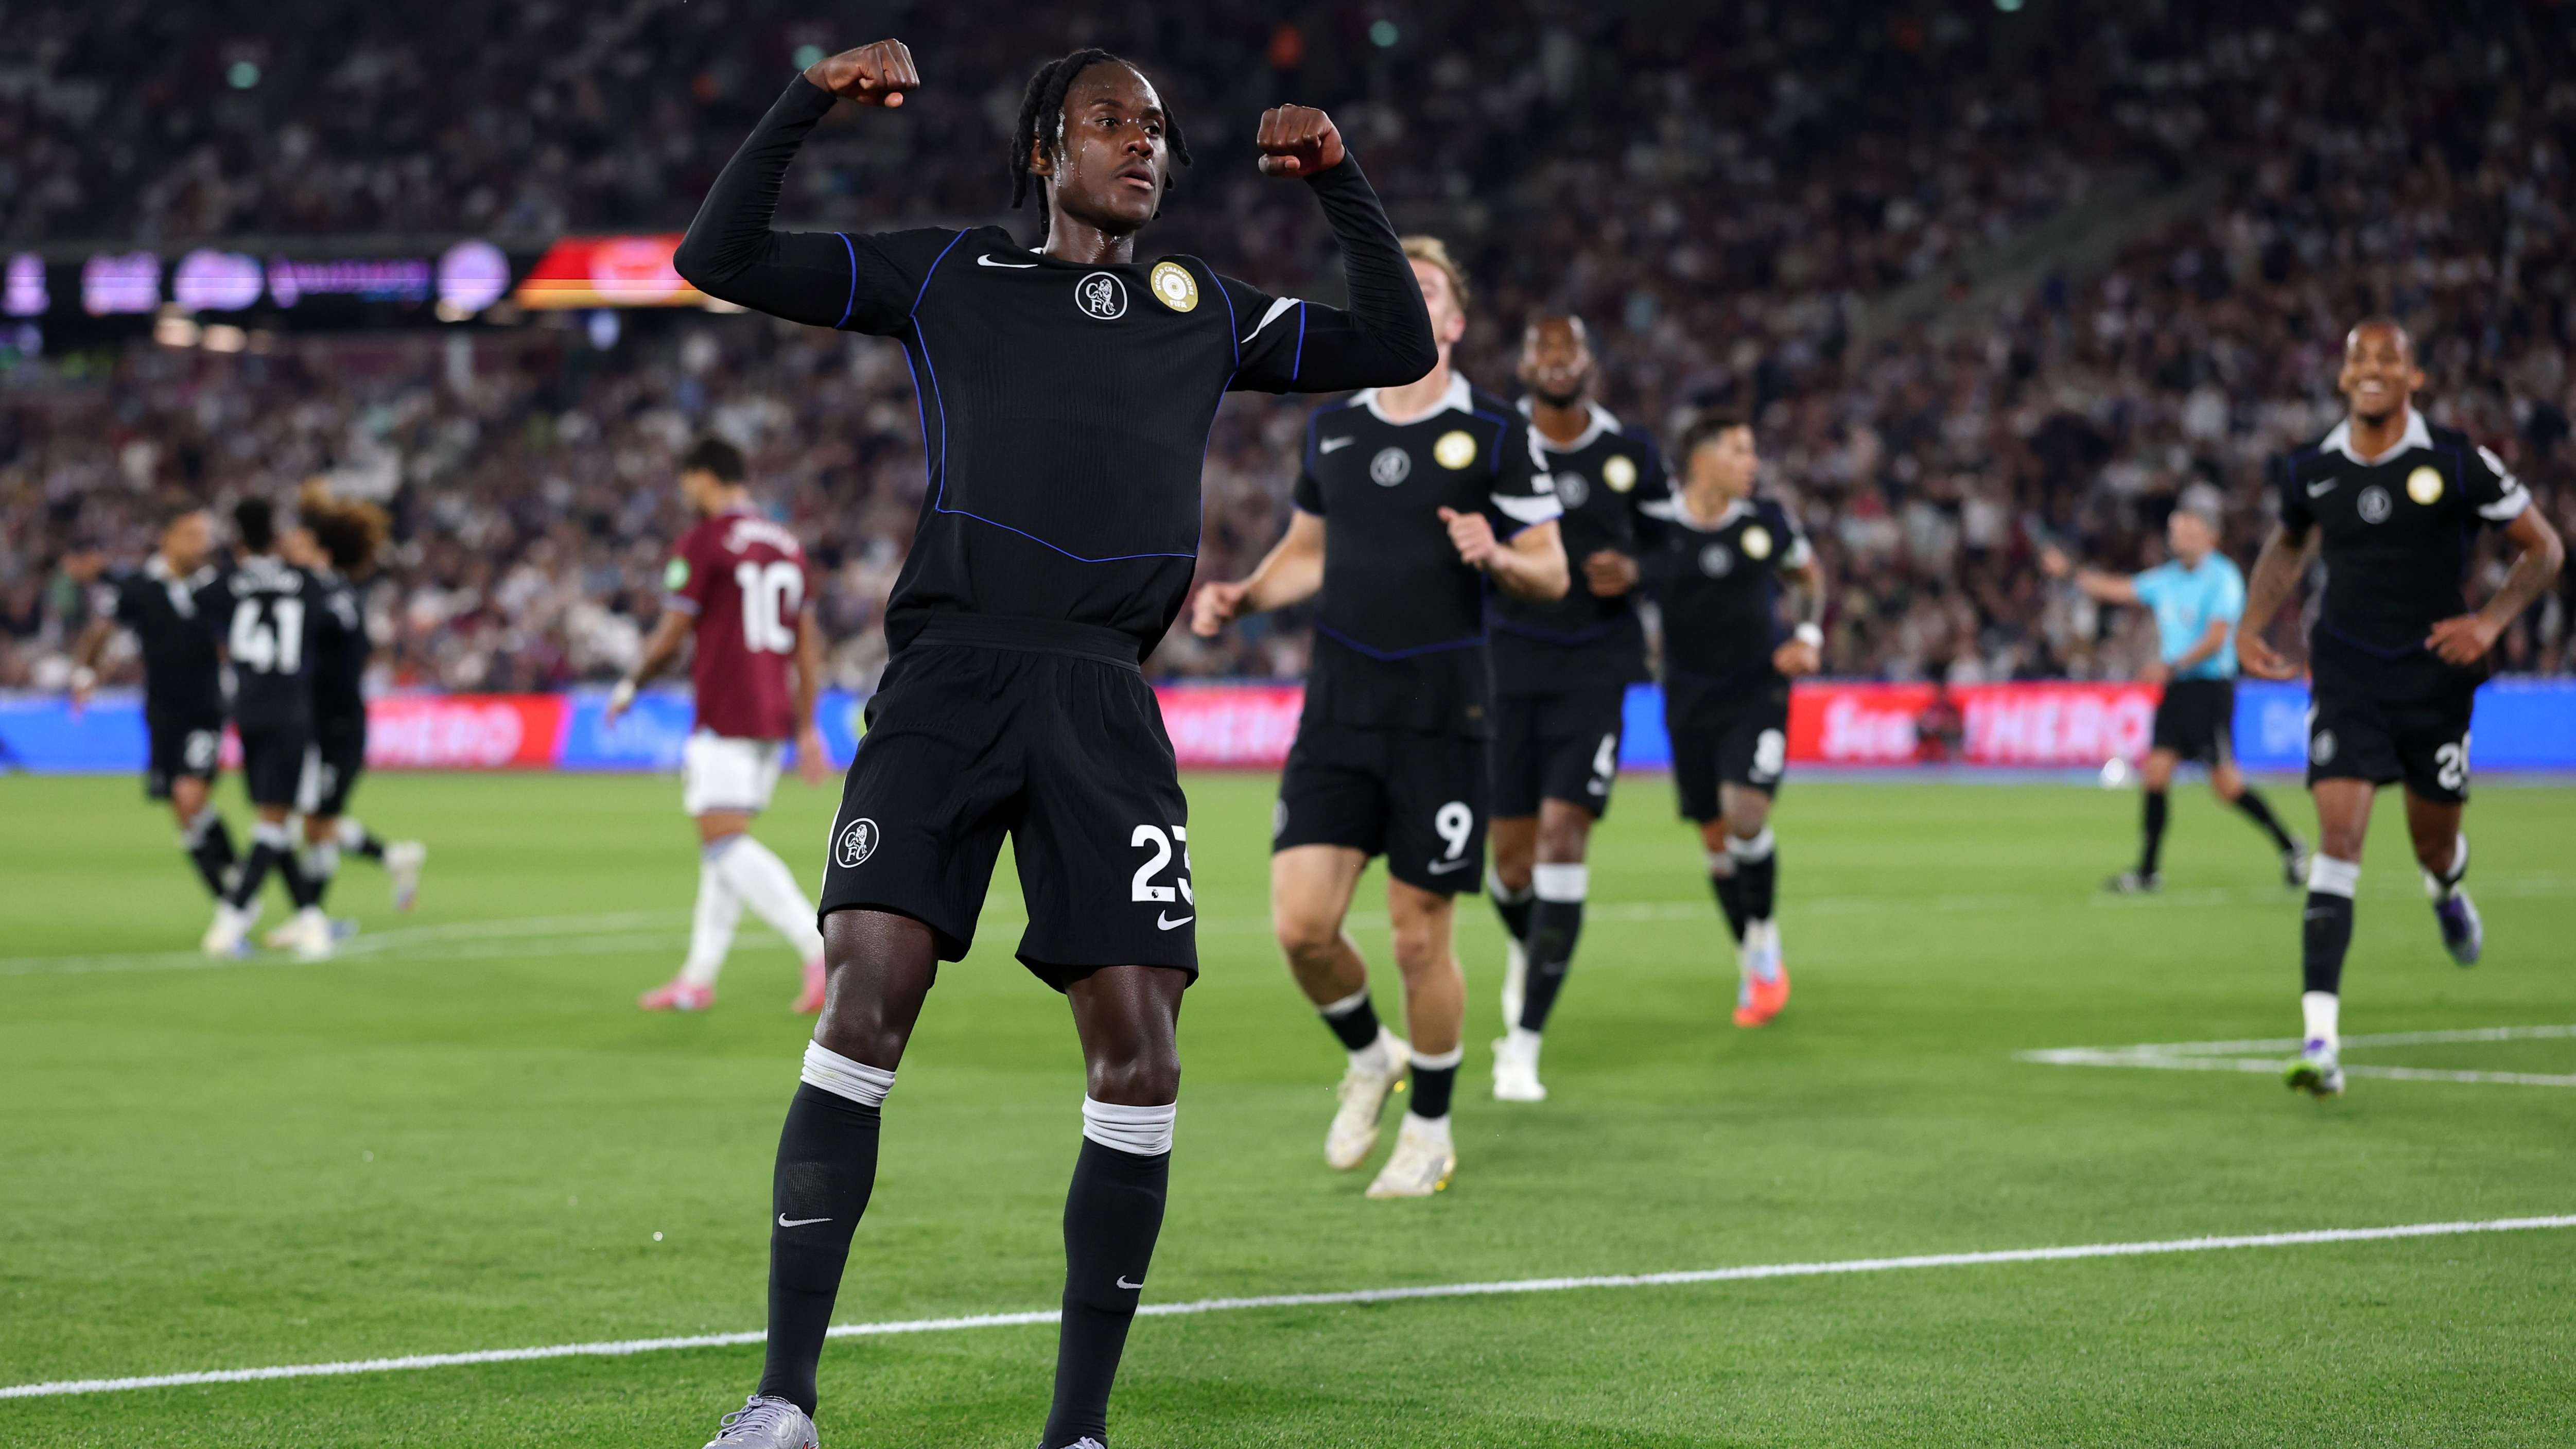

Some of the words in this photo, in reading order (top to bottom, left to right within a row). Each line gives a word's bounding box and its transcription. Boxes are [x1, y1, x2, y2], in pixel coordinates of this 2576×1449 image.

[1155, 268, 1165, 291] WORLD
[1164, 266, 1194, 296] CHAMPIONS
[1169, 299, 1187, 309] FIFA
[230, 596, 305, 673] 41
[734, 560, 805, 653] 10
[1435, 801, 1473, 860] 9
